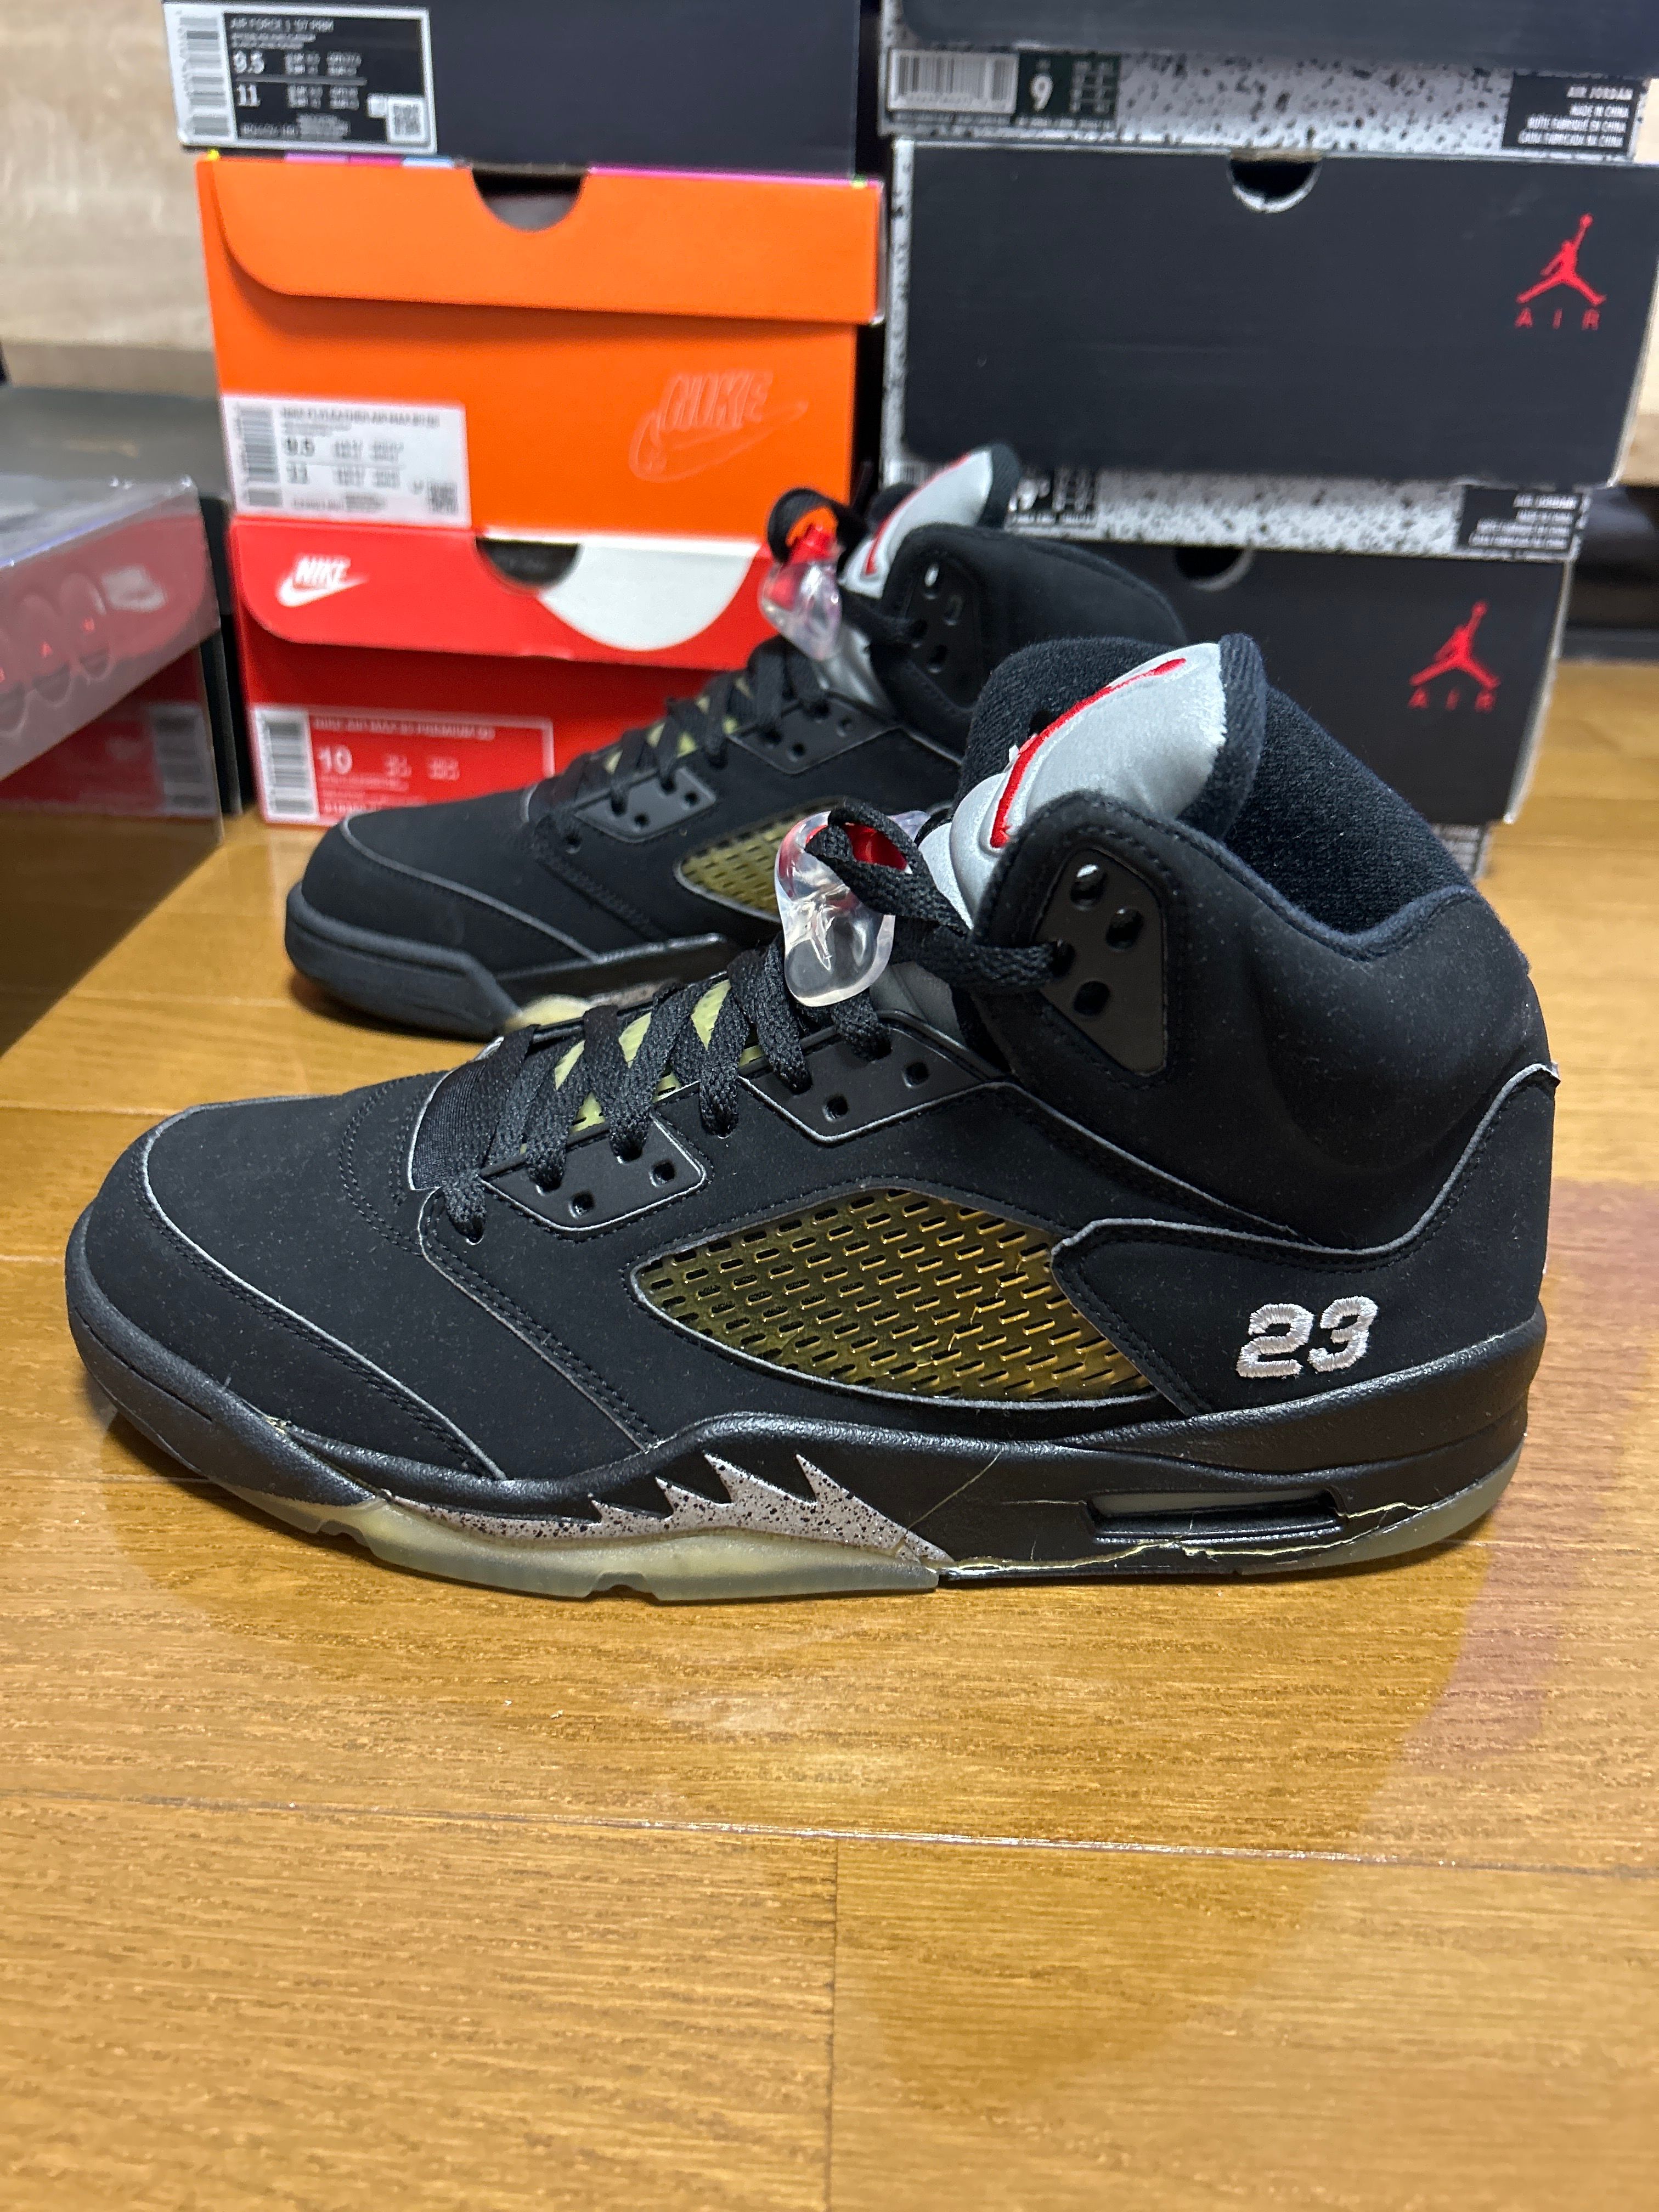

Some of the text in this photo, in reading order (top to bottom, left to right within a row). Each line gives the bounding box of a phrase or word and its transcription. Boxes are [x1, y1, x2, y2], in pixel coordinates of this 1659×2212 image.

[233, 50, 266, 75] 9.5
[236, 83, 261, 107] 11
[1030, 72, 1053, 111] 9
[1515, 306, 1600, 330] AIR
[660, 369, 774, 432] NIKE
[294, 554, 351, 588] NIKE
[1408, 686, 1497, 713] AIR
[317, 744, 353, 775] 10
[1236, 1296, 1378, 1378] 23
